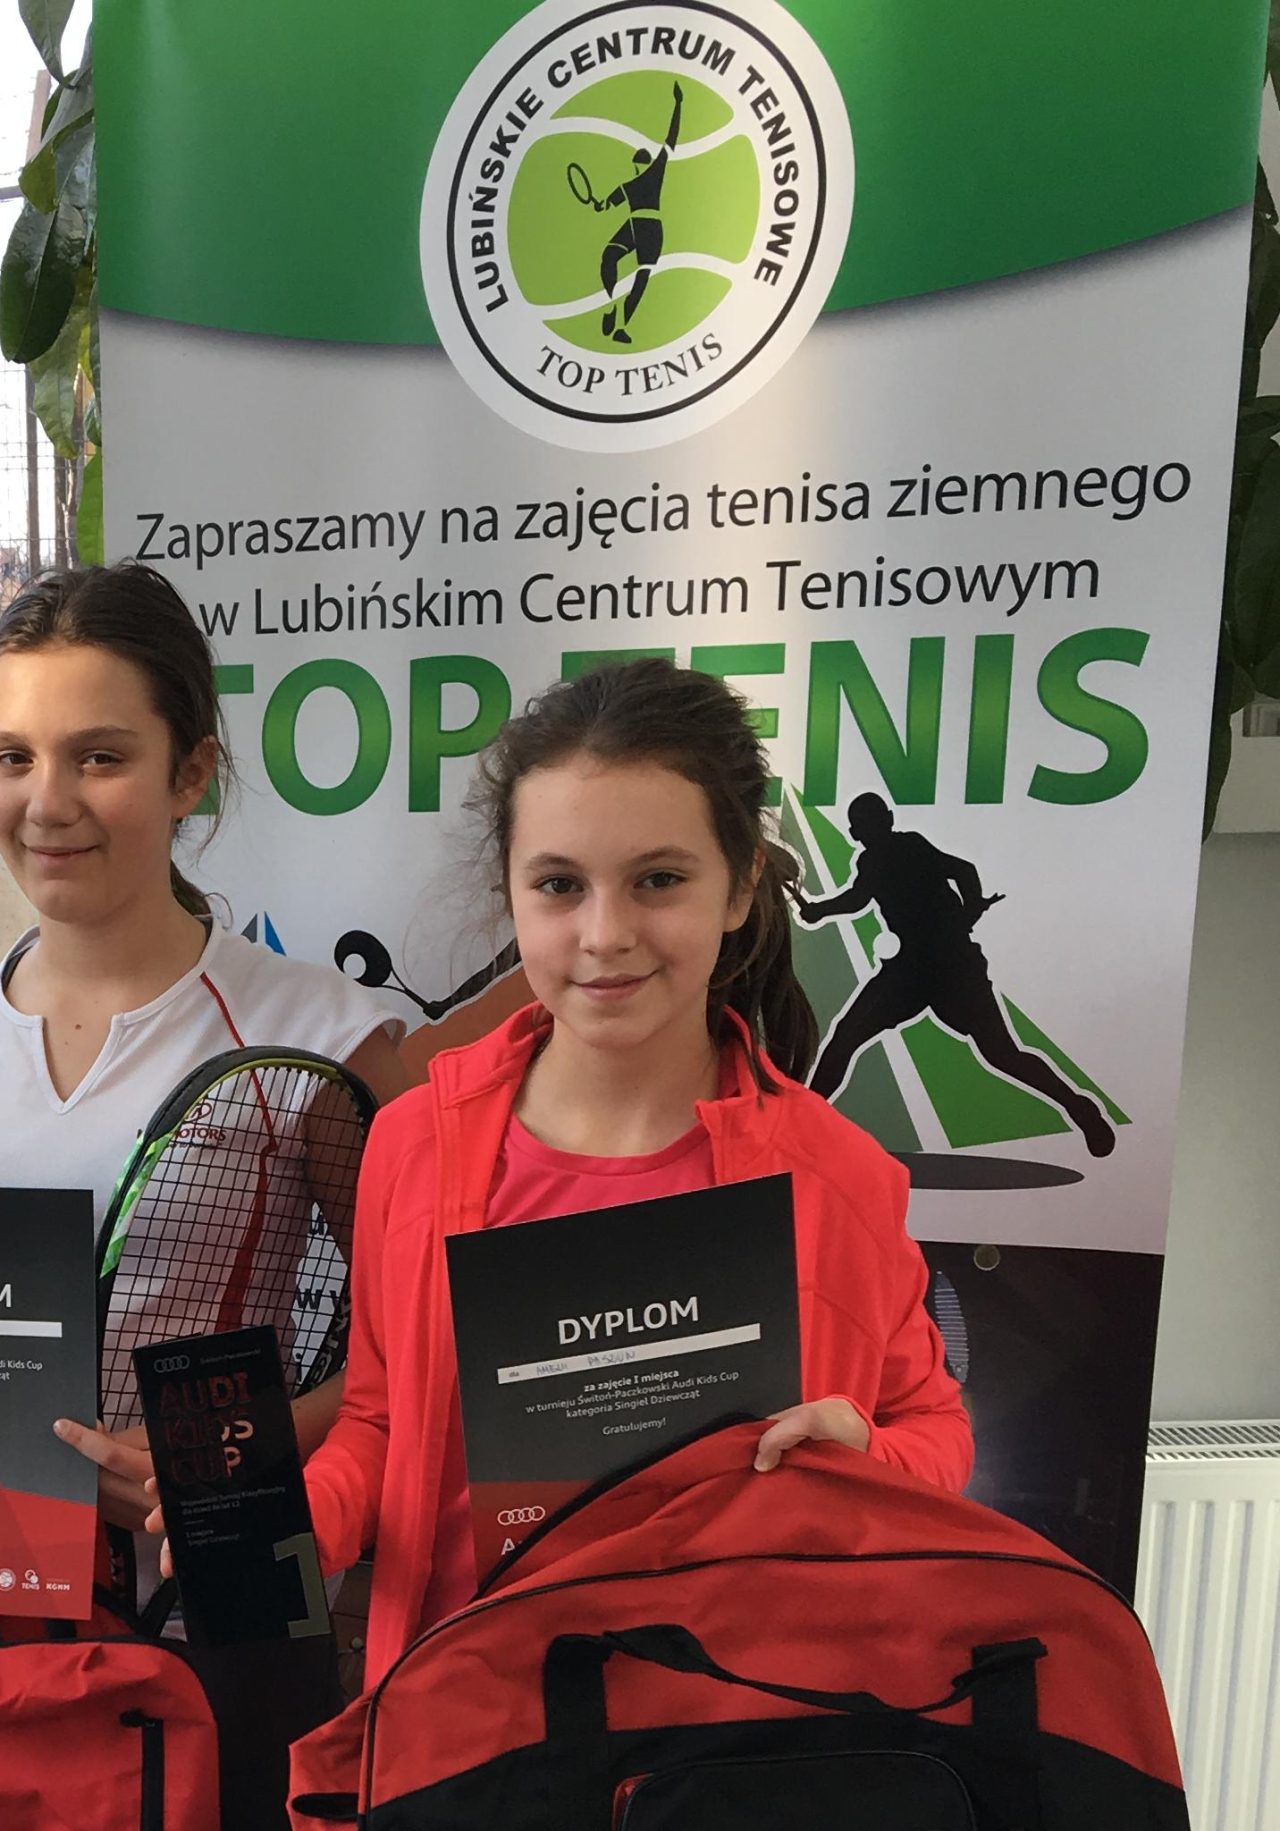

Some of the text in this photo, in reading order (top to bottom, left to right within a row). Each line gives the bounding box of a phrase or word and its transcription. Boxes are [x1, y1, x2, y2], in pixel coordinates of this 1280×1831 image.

[468, 26, 799, 312] LUBIŃSKIE CENTRUM TENISOWE
[535, 332, 723, 396] TOP TENIS
[136, 460, 1191, 570] Zapraszamy na zajęcia tenisa ziemnego
[200, 556, 1099, 636] w Lubińskim Centrum Tenisowym
[558, 1296, 699, 1345] DYPLOM
[7, 1361, 25, 1370] Kids
[26, 1362, 43, 1371] Cup
[584, 1369, 679, 1393] za zajęcie I miejsca
[160, 1372, 255, 1416] AUDI
[525, 1370, 740, 1414] w turnieju Świtoń-Paczkowski Audi Kids Cup
[566, 1389, 701, 1419] kategoria Singiel Dziewcząt
[602, 1417, 666, 1436] Gratulujemy!
[273, 1532, 332, 1639] 1
